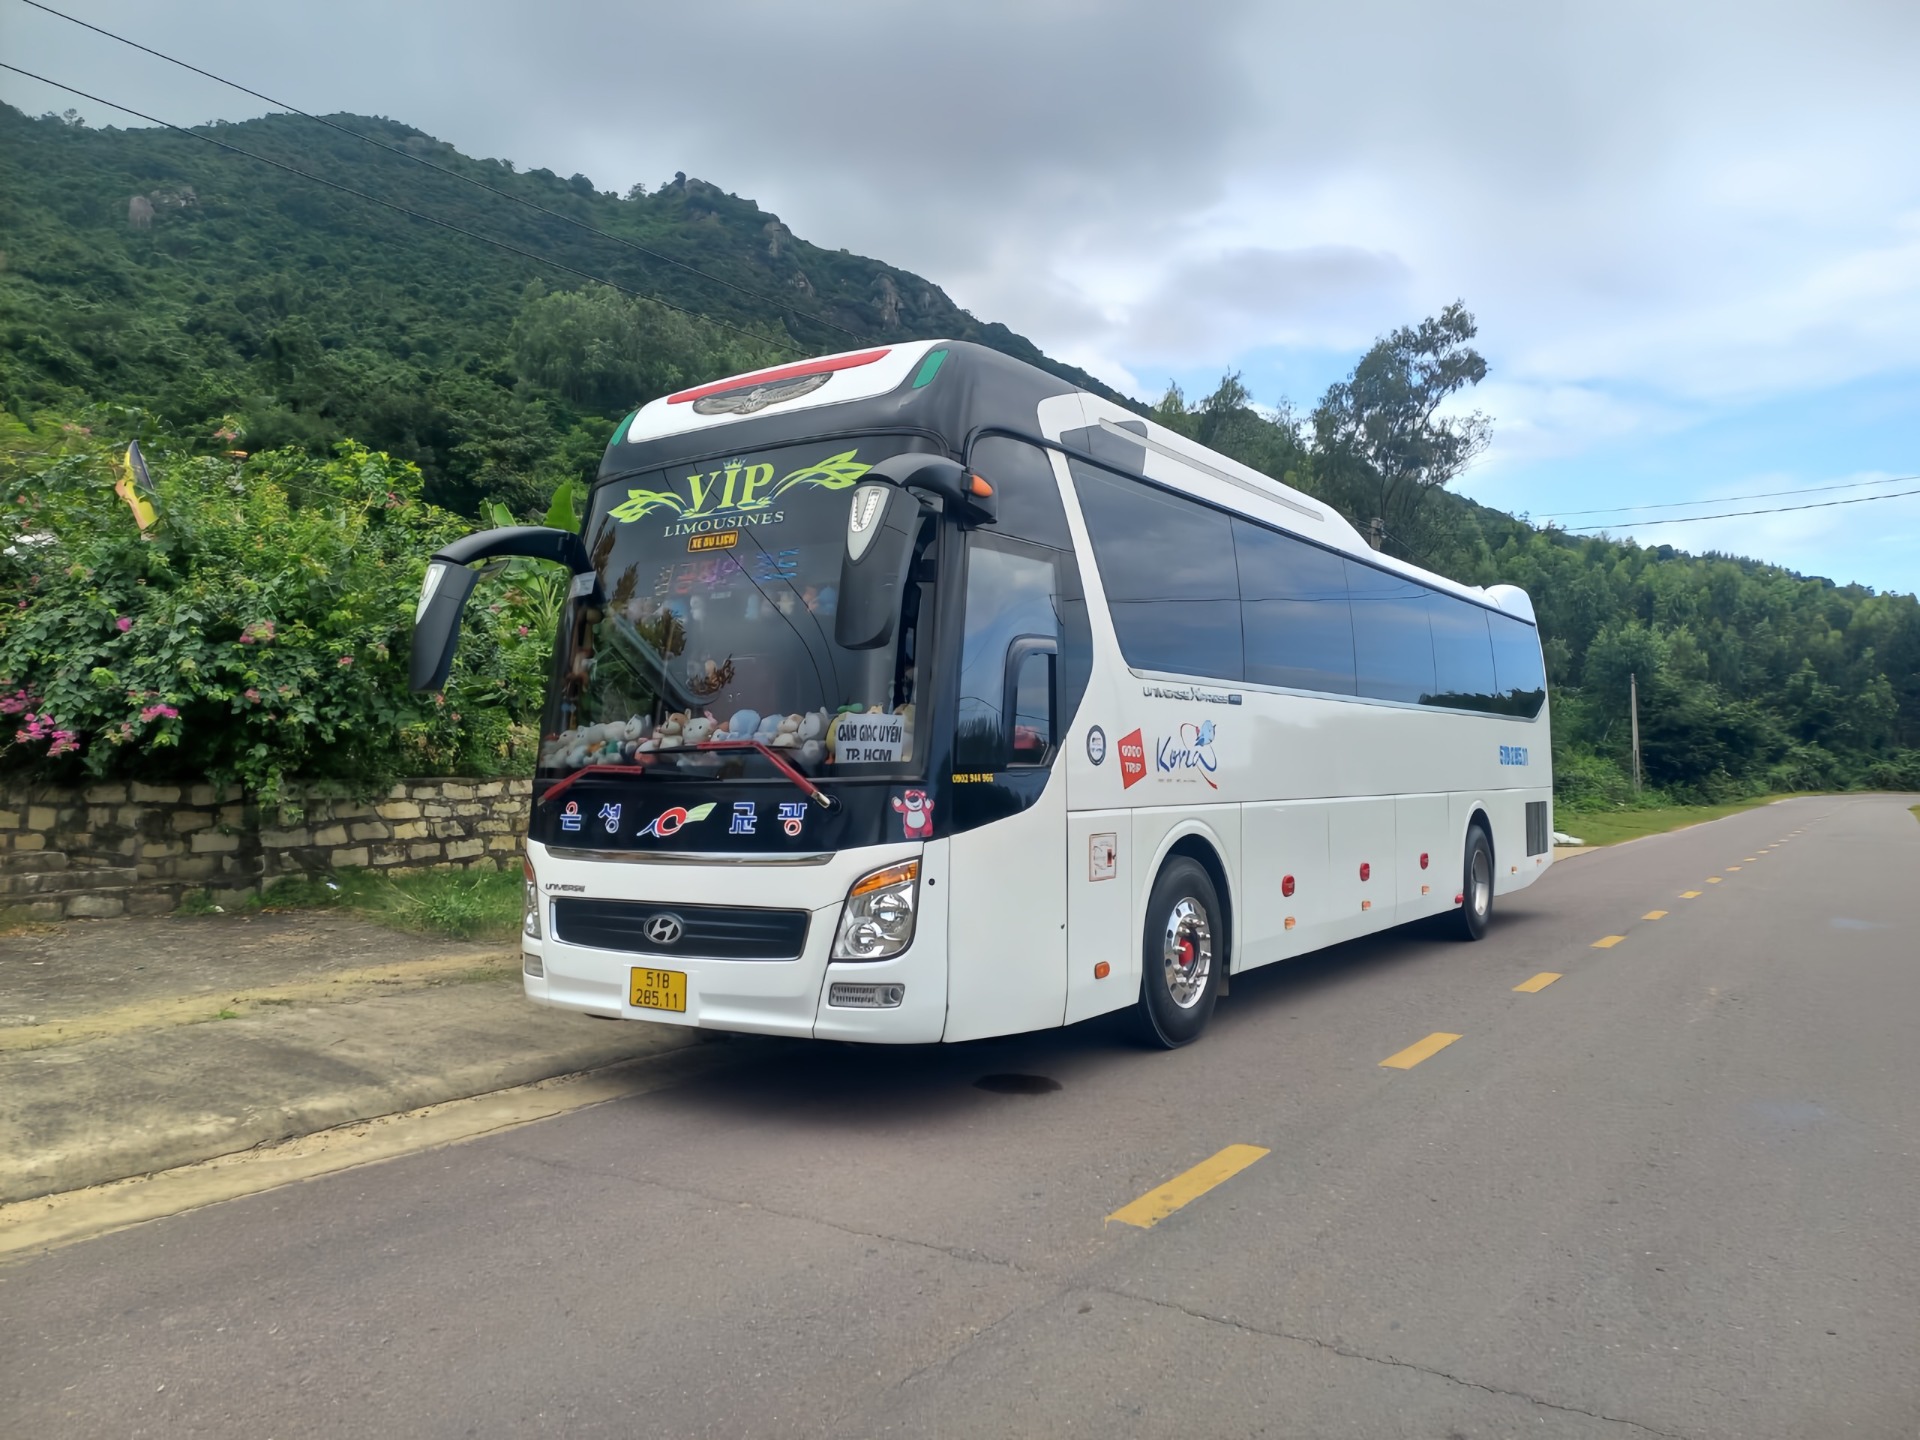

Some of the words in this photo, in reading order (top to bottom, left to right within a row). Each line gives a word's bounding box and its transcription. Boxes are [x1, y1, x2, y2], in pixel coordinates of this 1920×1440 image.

[686, 462, 775, 512] VIP
[663, 511, 785, 538] LIMOUSINES
[864, 748, 892, 762] HCM
[646, 971, 670, 989] 51B
[636, 988, 677, 1009] 285.11
